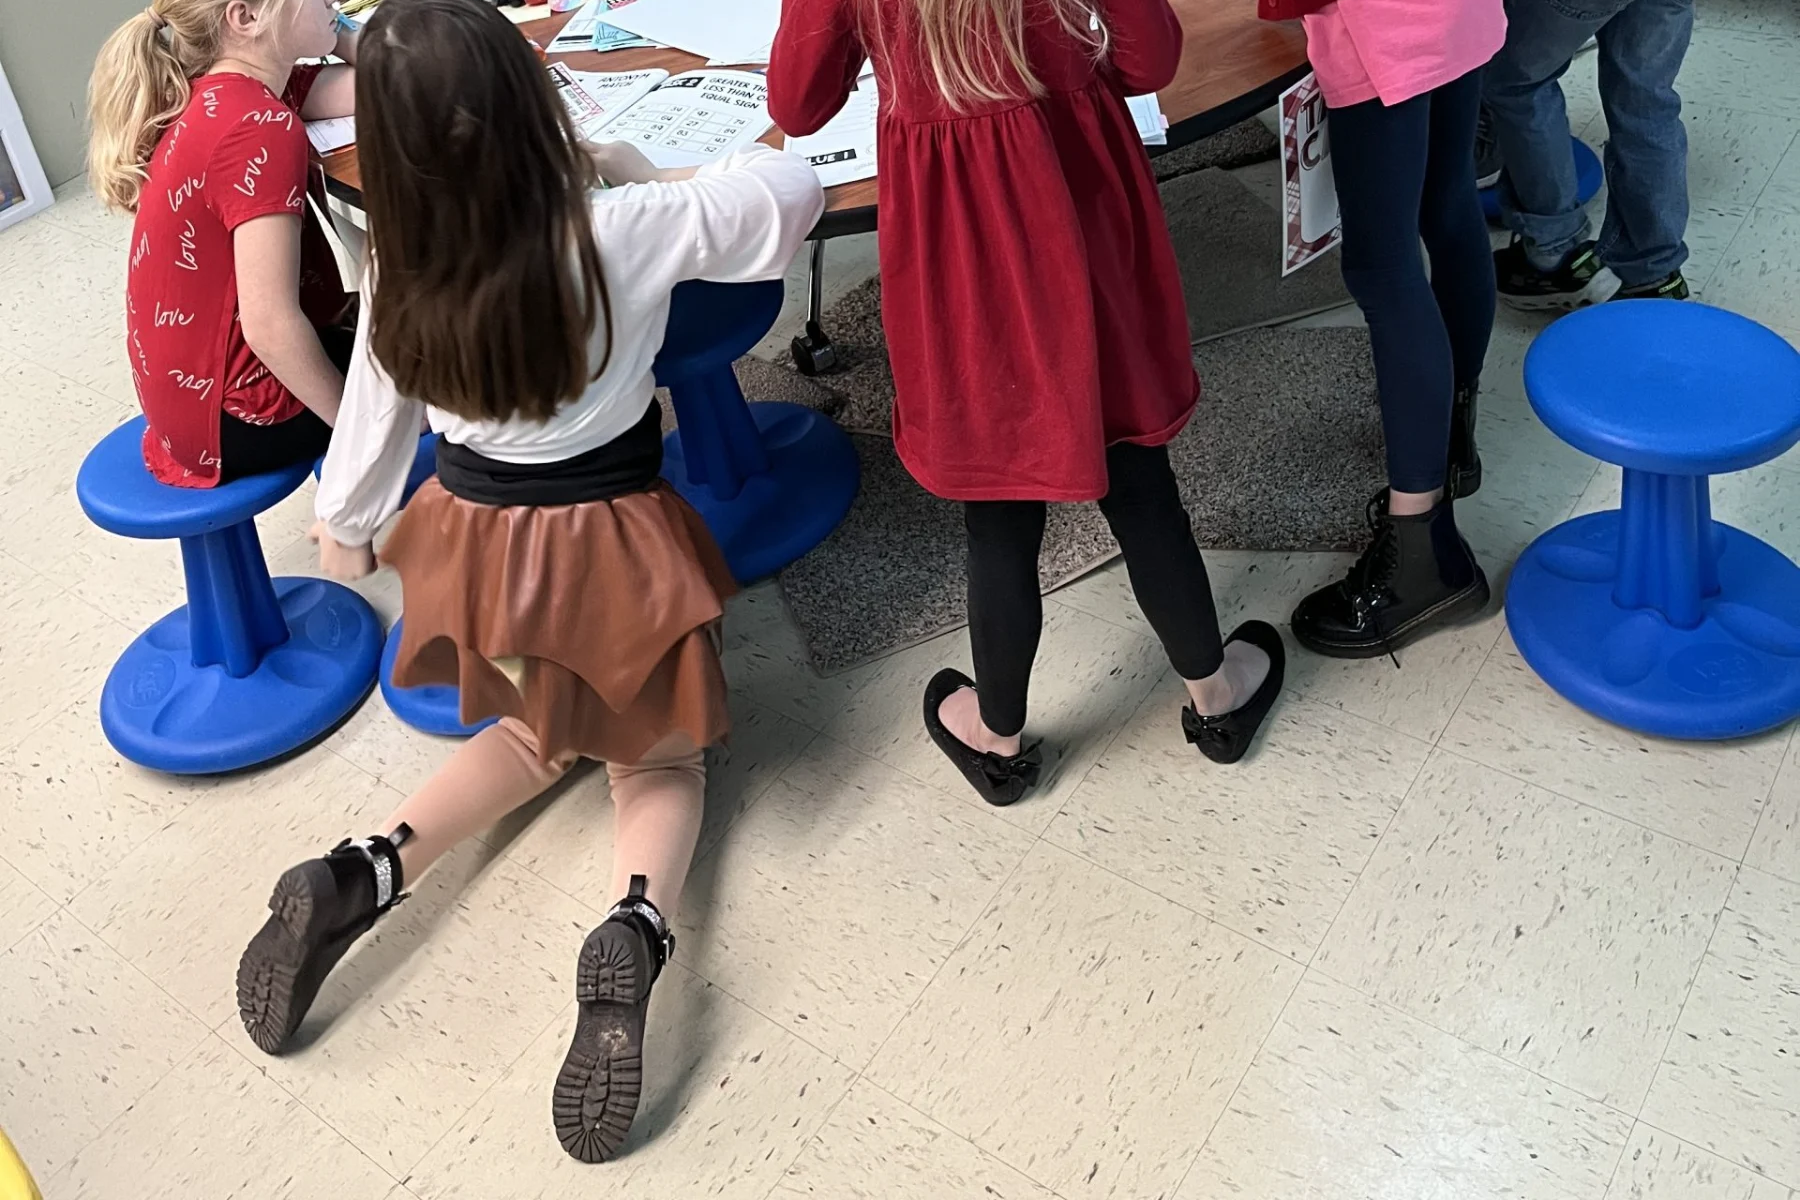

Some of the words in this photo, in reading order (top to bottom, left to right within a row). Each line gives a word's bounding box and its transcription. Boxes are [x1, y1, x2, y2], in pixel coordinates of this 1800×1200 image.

[703, 84, 724, 93] LESS
[727, 87, 755, 99] THAN
[709, 77, 751, 88] GREATER
[202, 85, 223, 118] love
[700, 92, 731, 104] EQUAL
[733, 99, 760, 110] SIGN
[242, 110, 293, 131] love
[233, 146, 268, 197] love
[807, 153, 836, 166] LUE
[168, 171, 206, 212] love
[175, 218, 198, 270] love
[155, 301, 195, 327] love
[168, 369, 214, 401] love
